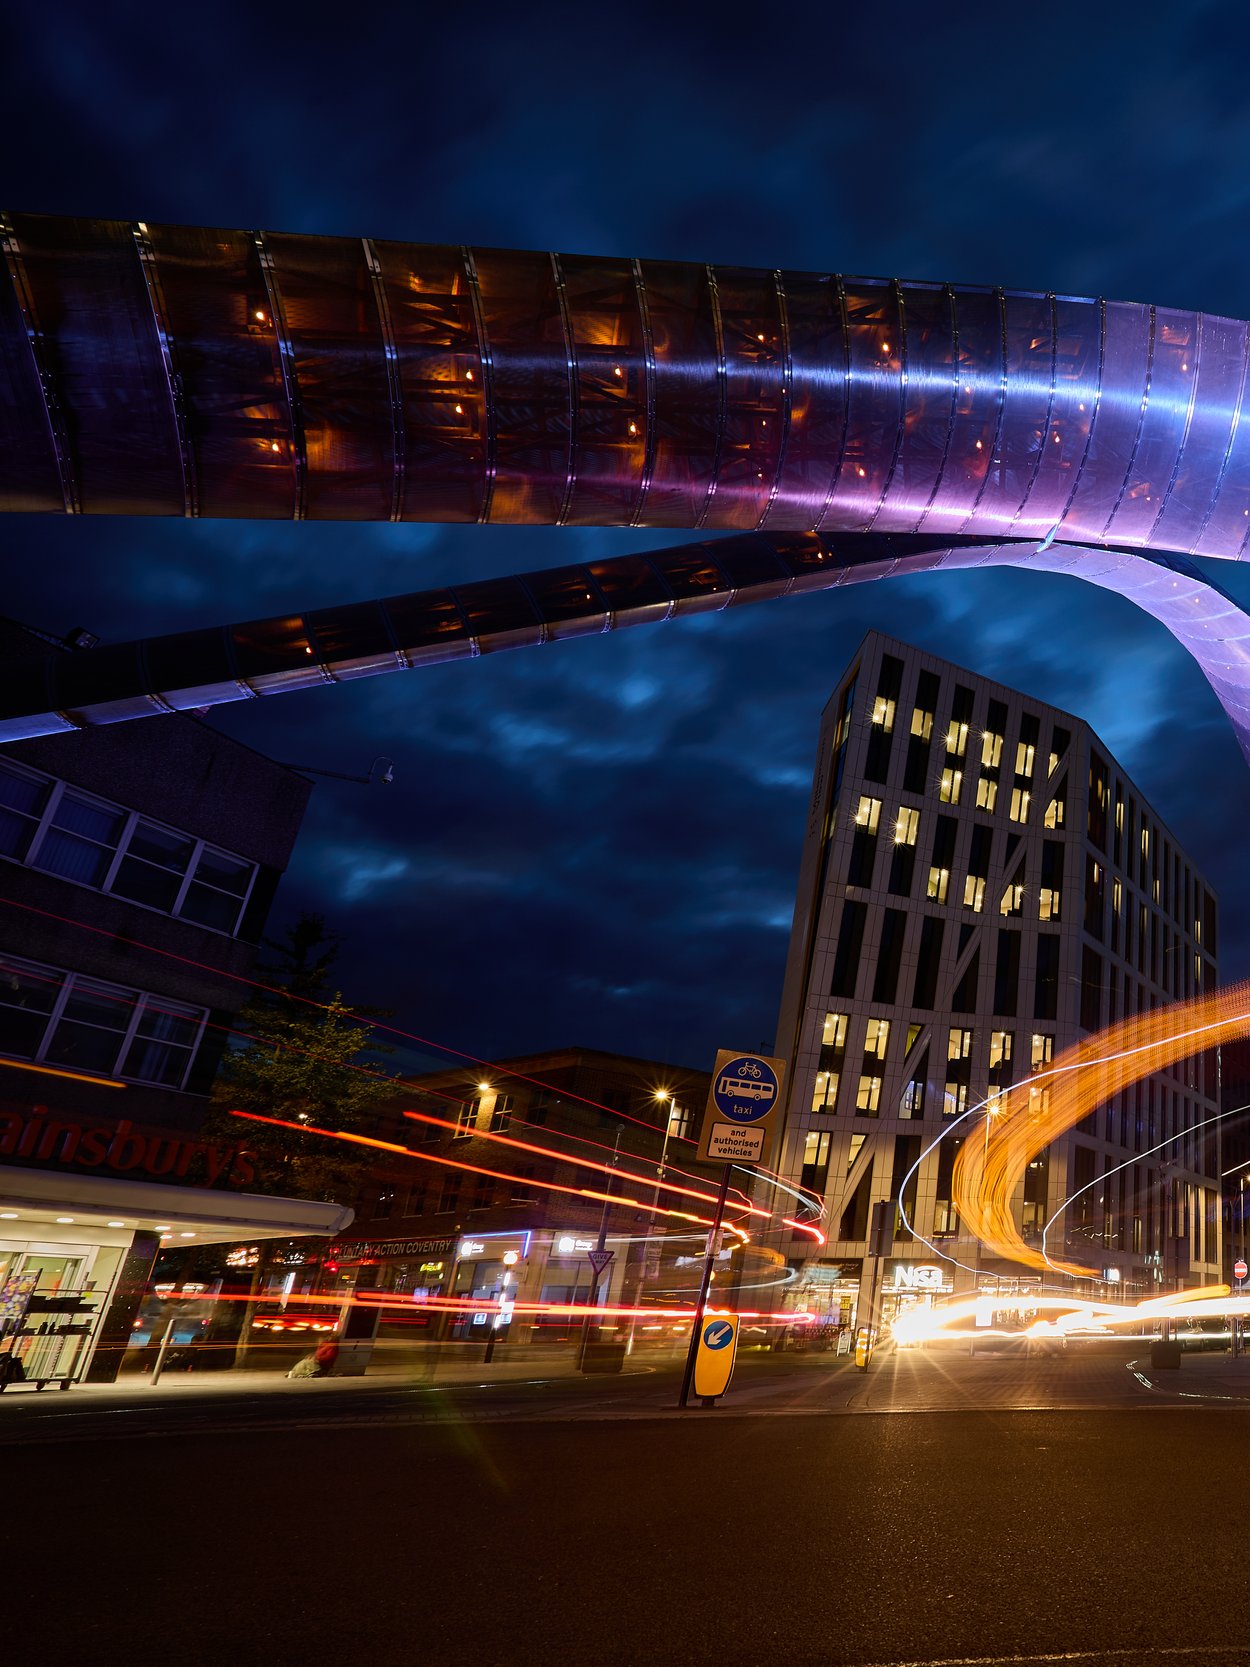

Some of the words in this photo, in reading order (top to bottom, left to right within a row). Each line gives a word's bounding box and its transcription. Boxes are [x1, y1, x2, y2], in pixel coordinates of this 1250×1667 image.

[733, 1105, 752, 1115] taxi
[0, 1104, 257, 1188] ainsbury's
[714, 1137, 760, 1148] authorised
[718, 1148, 752, 1156] vehicles
[375, 1243, 405, 1256] ACTION
[406, 1240, 451, 1254] COVENTRY
[894, 1265, 943, 1287] Nisa
